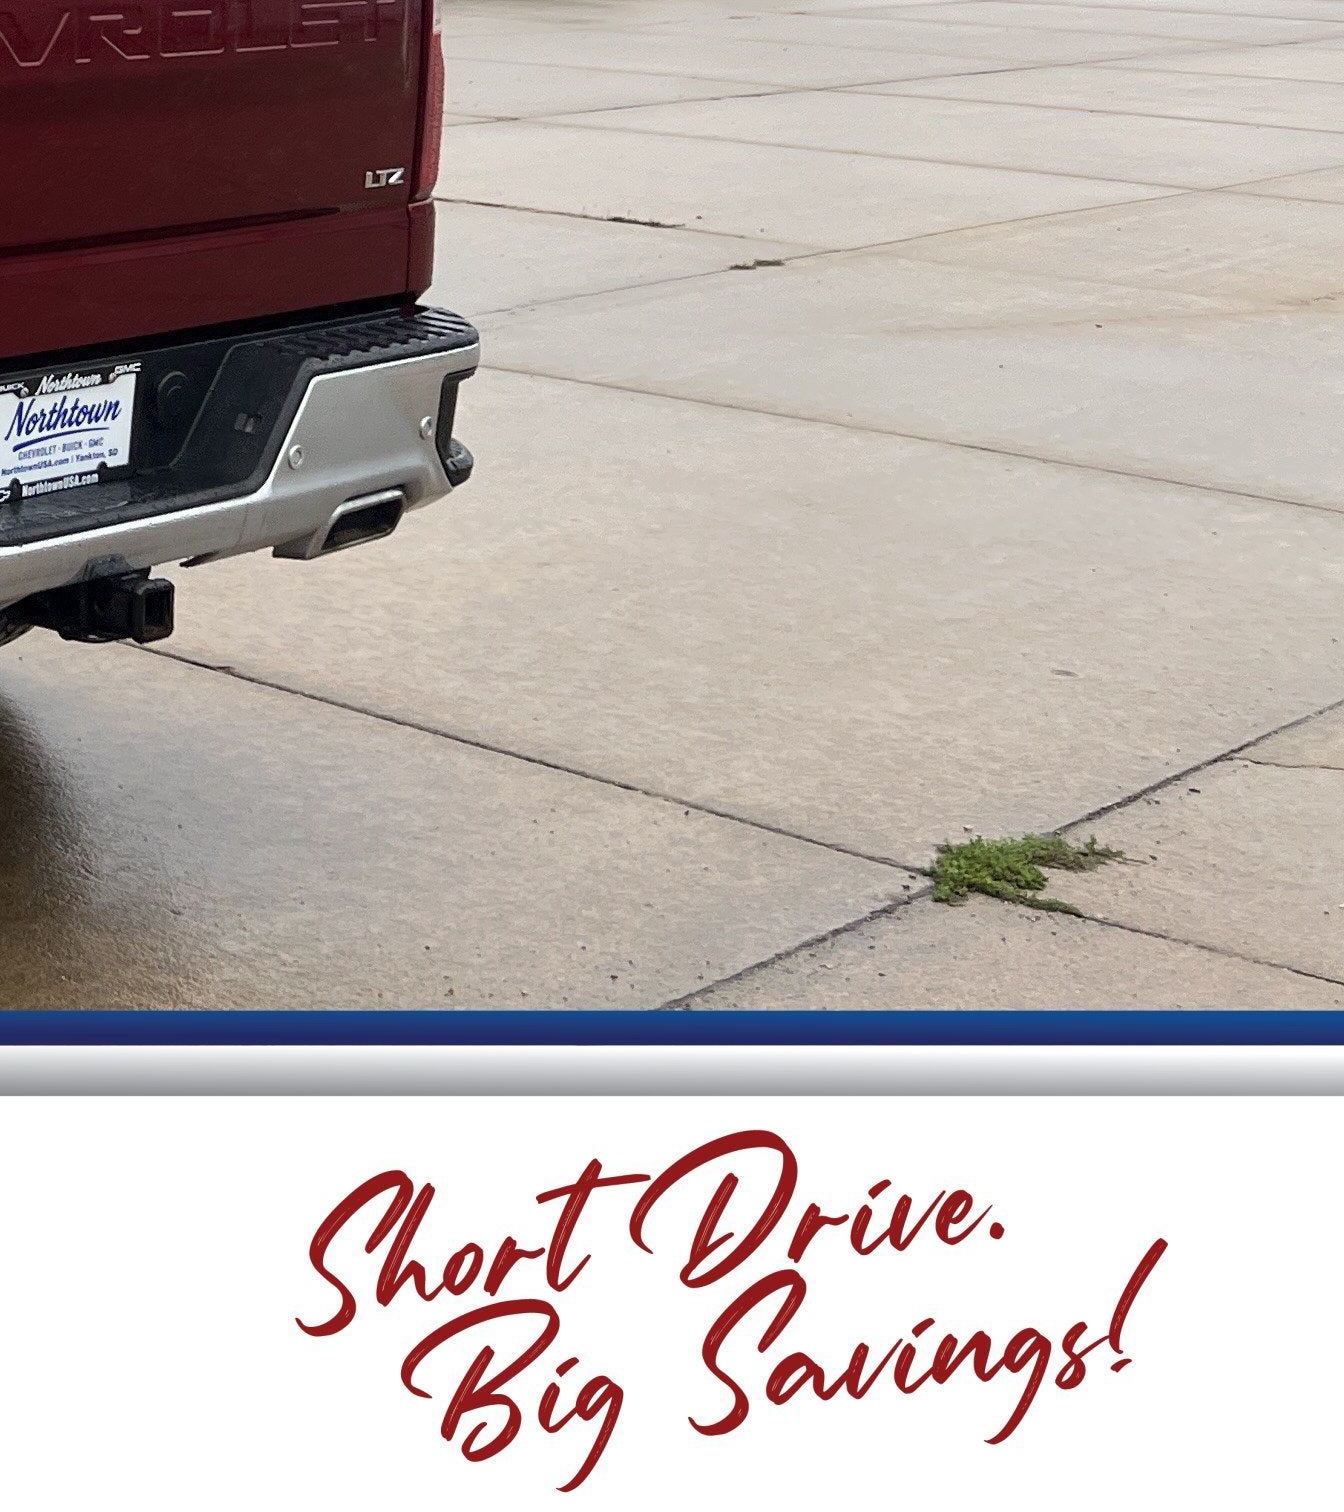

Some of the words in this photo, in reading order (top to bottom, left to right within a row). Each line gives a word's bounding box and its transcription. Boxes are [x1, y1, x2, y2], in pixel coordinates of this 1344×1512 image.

[364, 167, 406, 190] LTZ
[35, 373, 102, 396] Northtown
[114, 362, 142, 372] GMC
[4, 395, 122, 441] Northtown
[21, 472, 99, 498] NorthtownUSA.com
